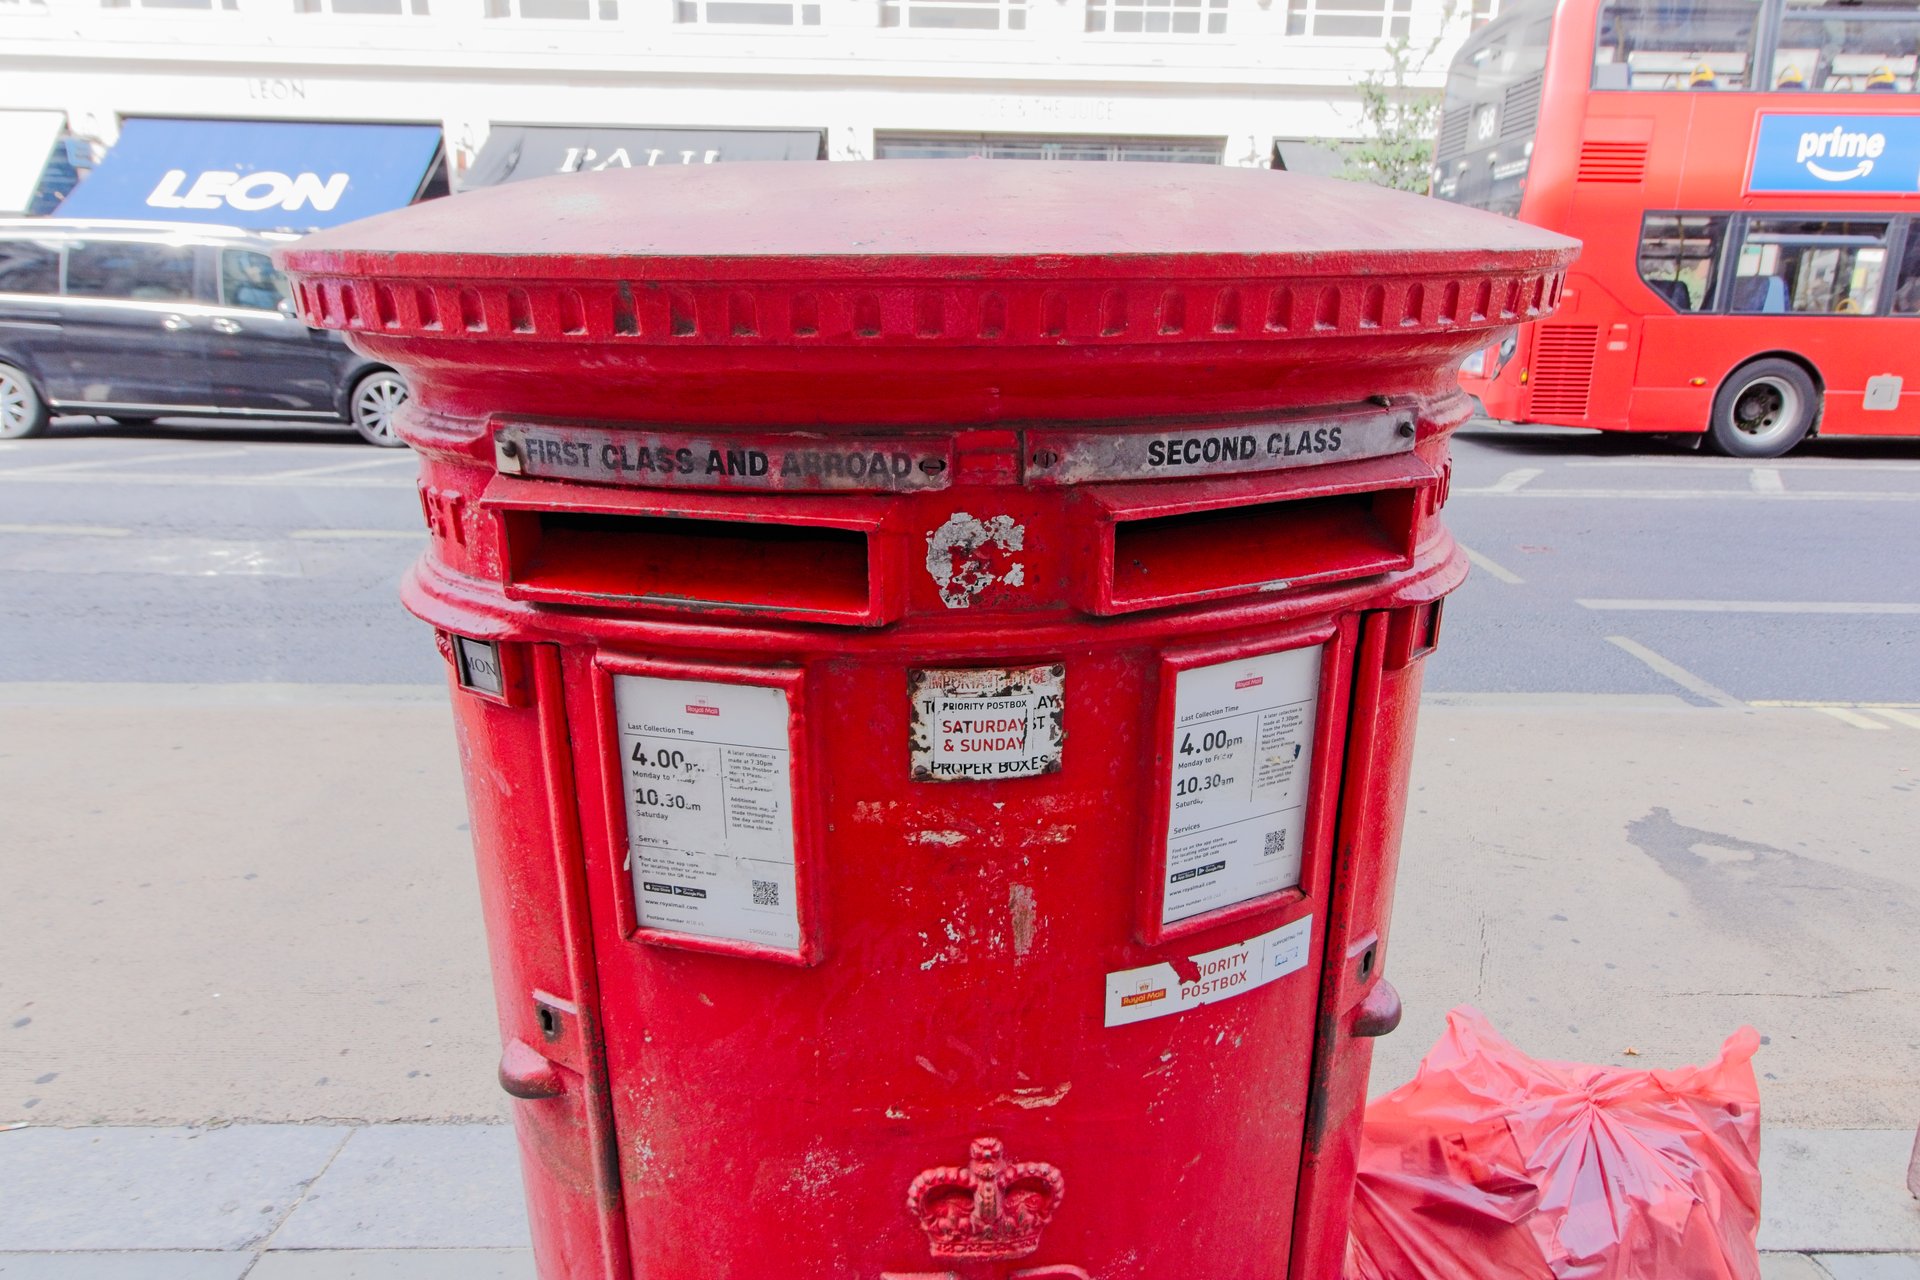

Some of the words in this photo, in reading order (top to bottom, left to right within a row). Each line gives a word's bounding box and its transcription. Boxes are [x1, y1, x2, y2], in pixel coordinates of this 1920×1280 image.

[247, 78, 306, 100] LEON
[1479, 108, 1496, 140] 88
[1796, 125, 1886, 163] prime
[145, 168, 351, 212] LEON
[1147, 433, 1257, 467] SECOND
[1266, 426, 1342, 458] CLASS
[525, 437, 593, 469] FIRST
[601, 443, 695, 476] CLASS
[705, 450, 769, 478] AND
[780, 450, 913, 479] ABROAD
[1250, 676, 1263, 686] Mail
[687, 705, 704, 714] Royal
[705, 707, 719, 715] Mail
[942, 702, 985, 711] PRIORITY
[986, 700, 1027, 710] POSTBOX
[1180, 713, 1194, 722] Last
[1195, 708, 1224, 719] Collection
[1225, 705, 1239, 713] Time
[627, 723, 642, 731] Last
[643, 724, 676, 734] Collection
[677, 727, 695, 736] Time
[942, 718, 1027, 734] SATURDAY
[943, 740, 955, 752] &
[960, 737, 1026, 752] SUNDAY
[1179, 729, 1243, 756] 4.00pm
[931, 761, 993, 775] PROPER
[998, 754, 1049, 774] BOXES
[1178, 758, 1204, 770] Monday
[632, 770, 661, 781] Monday
[1176, 773, 1234, 797] 10.30am
[636, 809, 669, 821] Saturday
[1173, 823, 1201, 835] Services
[1168, 879, 1217, 897] www.royalmail.com
[645, 899, 698, 911] www.royalmail.com
[1272, 935, 1296, 947] SUPPORTING
[1196, 951, 1249, 979] RIORITY
[1181, 970, 1247, 1000] POSTBOX
[1122, 992, 1146, 1006] Royal
[1147, 989, 1165, 1000] Mail
